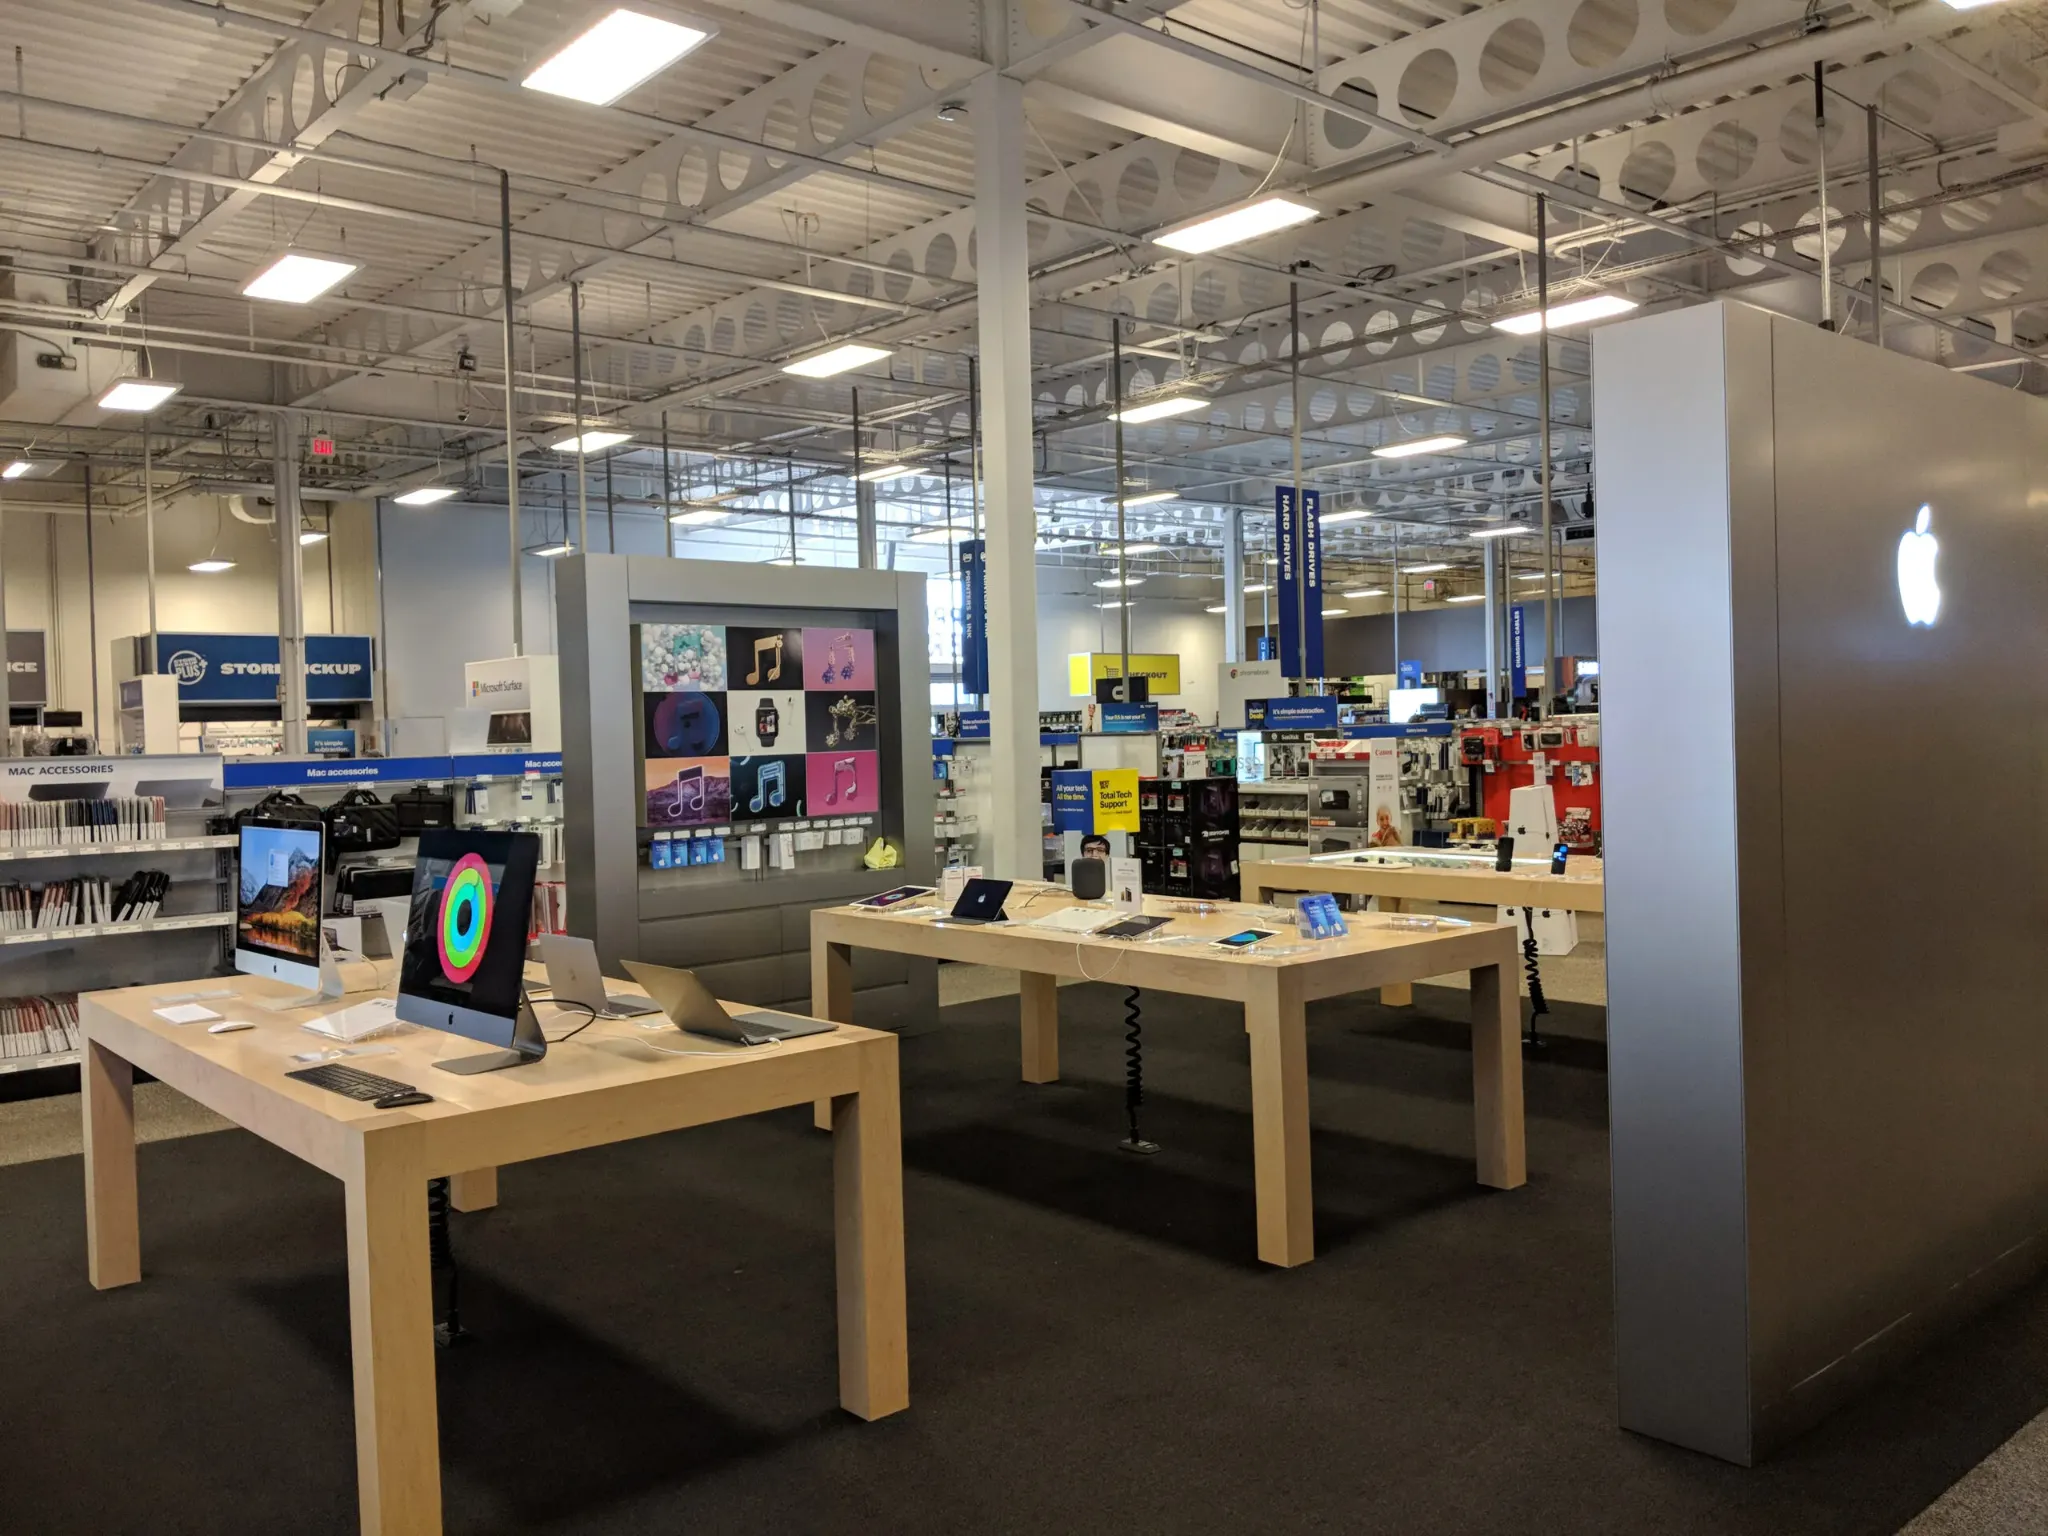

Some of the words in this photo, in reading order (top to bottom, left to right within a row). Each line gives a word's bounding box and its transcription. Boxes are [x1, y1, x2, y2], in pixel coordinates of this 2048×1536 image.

[1307, 498, 1315, 538] FLASH
[1283, 534, 1291, 580] DRIVES
[1308, 542, 1316, 587] DRIVES
[304, 664, 361, 674] ICKUP
[481, 682, 503, 693] Microsoft
[504, 680, 522, 691] Surface
[1281, 709, 1296, 717] simple
[525, 760, 541, 768] Mac
[8, 767, 34, 776] MAC
[39, 765, 114, 775] ACCESSORIES
[307, 768, 326, 777] Mac
[328, 767, 378, 775] accessories
[1100, 791, 1116, 799] Total
[1117, 790, 1132, 798] Tech
[1100, 800, 1127, 809] Support
